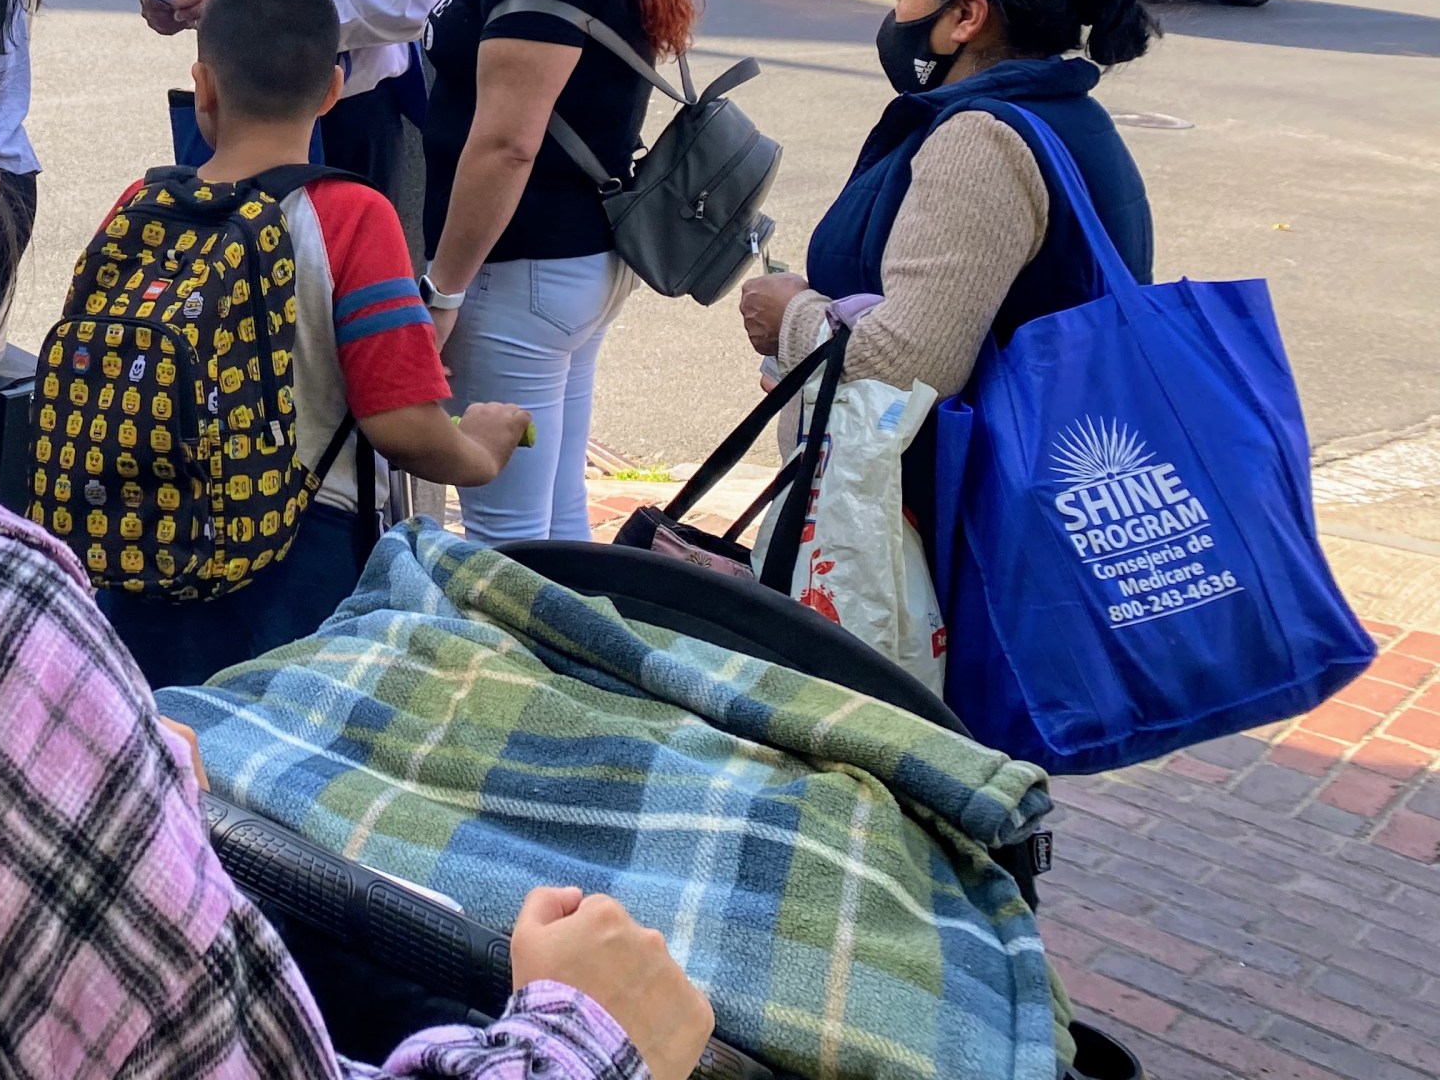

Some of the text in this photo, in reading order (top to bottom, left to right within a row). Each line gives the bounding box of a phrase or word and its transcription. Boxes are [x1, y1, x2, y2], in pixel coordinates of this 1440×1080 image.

[1054, 462, 1191, 532] SHINE
[1069, 497, 1210, 558] PROGRAM
[1186, 531, 1215, 556] de
[1108, 569, 1238, 624] 800-243-4636
[1117, 561, 1205, 598] Medicare
